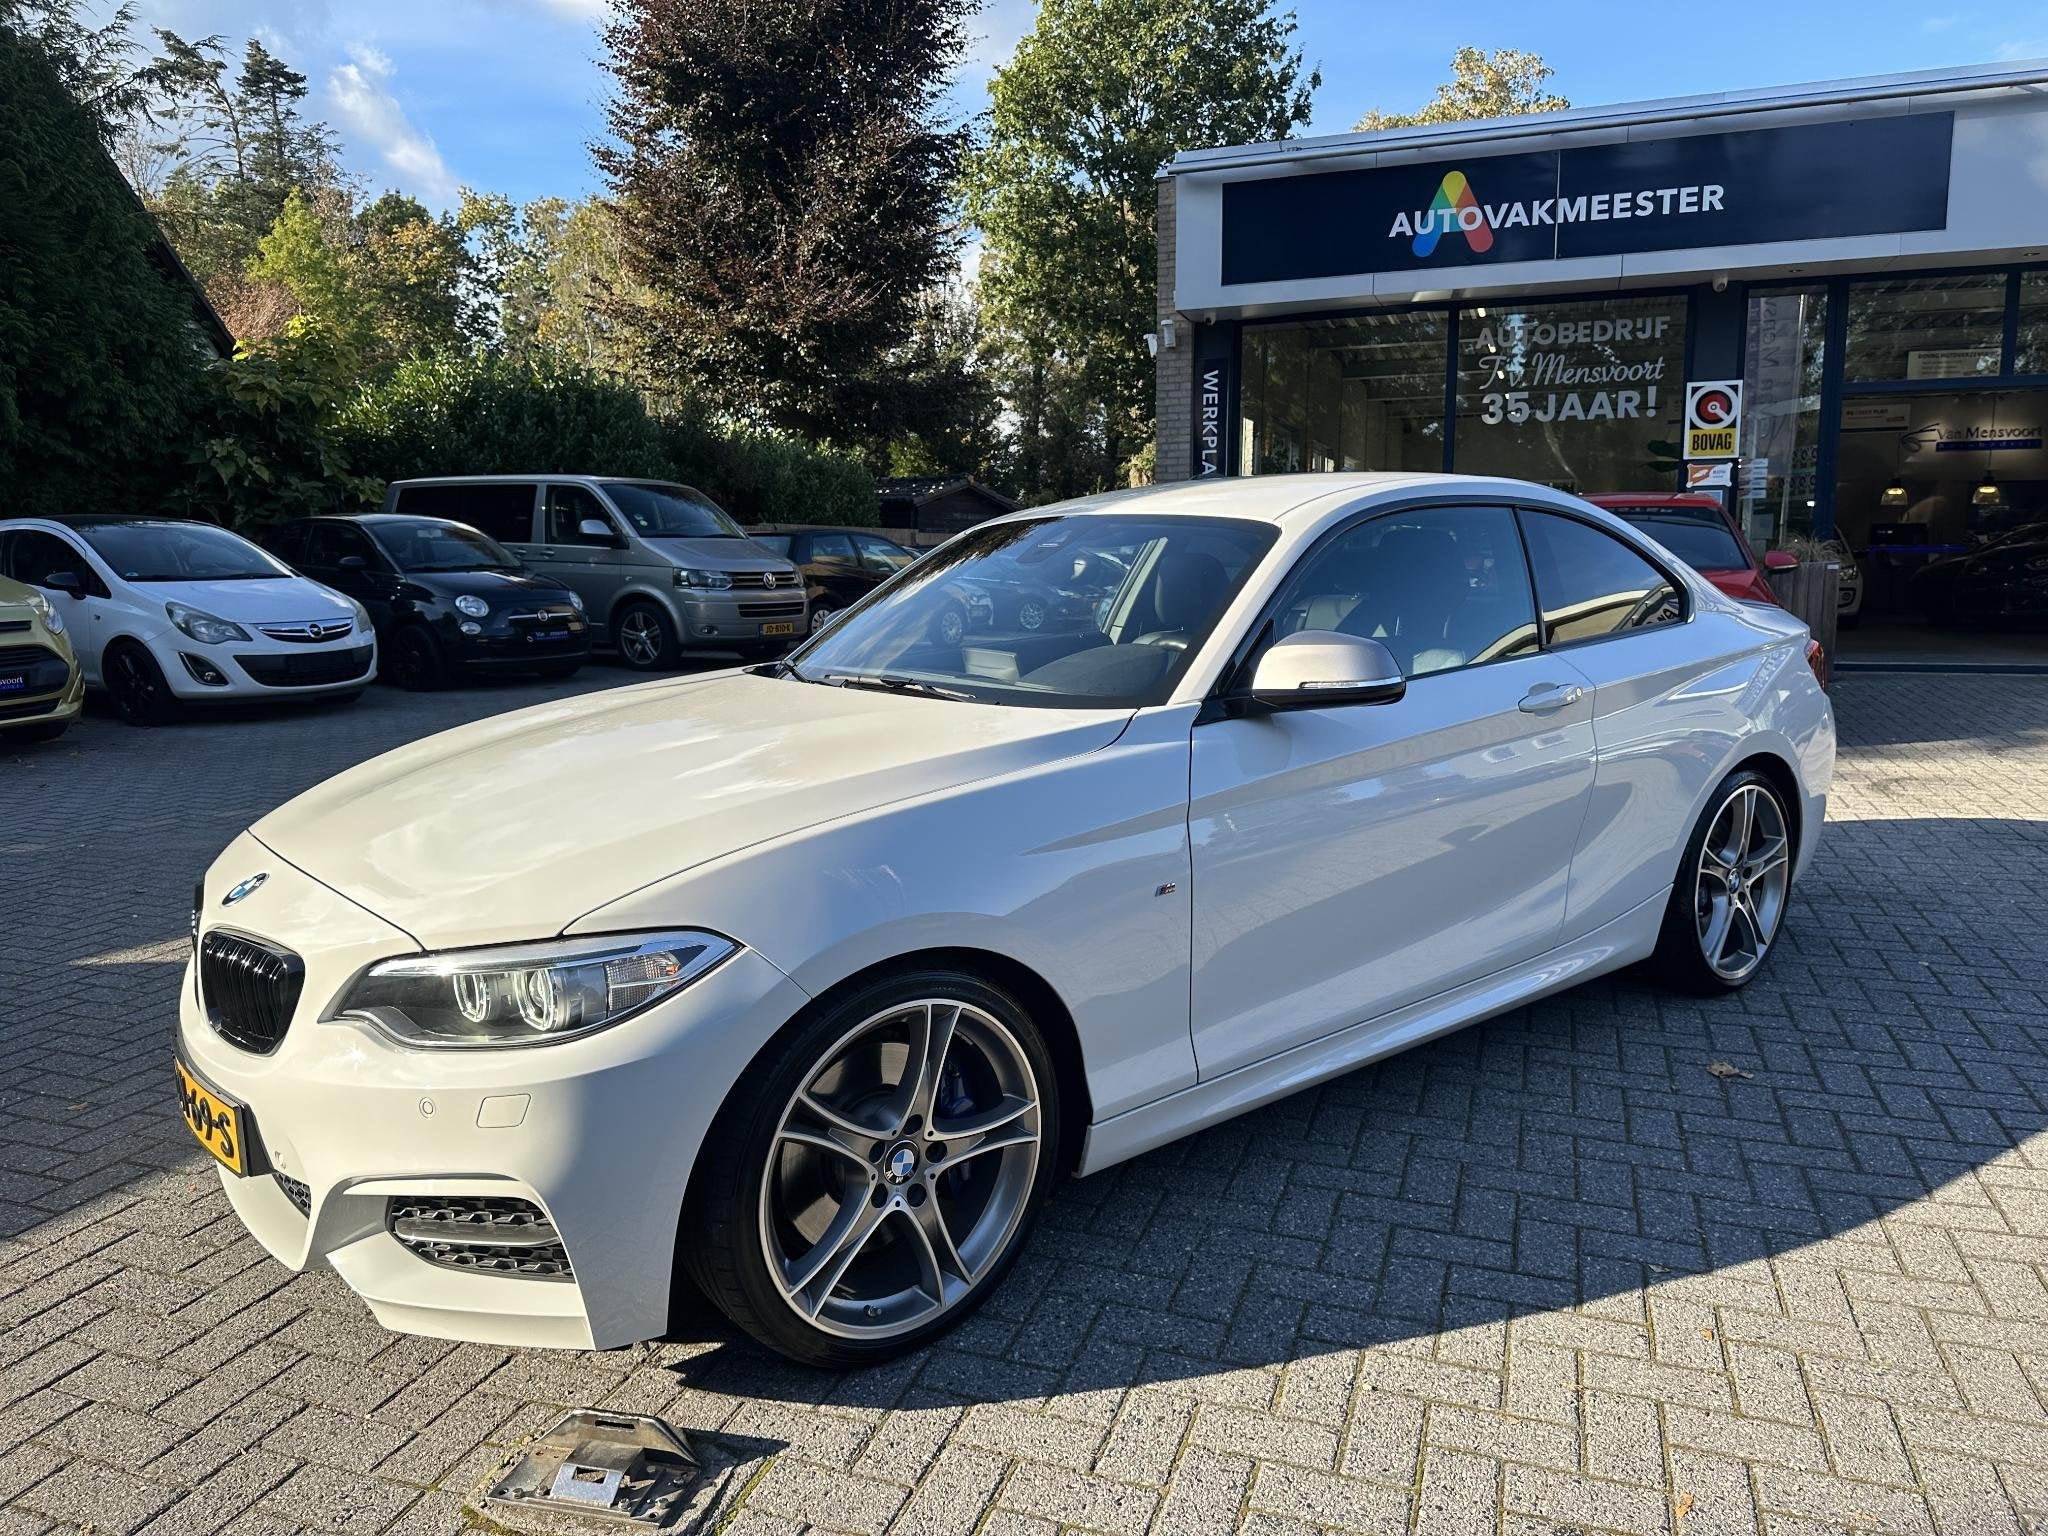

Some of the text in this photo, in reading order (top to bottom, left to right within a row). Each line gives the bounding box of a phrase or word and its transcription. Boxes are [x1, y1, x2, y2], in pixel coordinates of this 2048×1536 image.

[1388, 184, 1724, 238] AUTOVAKMEESTER
[1476, 316, 1671, 349] AUTOBEDRIJF
[1532, 352, 1665, 386] Mensvoort
[1201, 369, 1219, 475] WERKPLA
[1481, 385, 1657, 425] 35 JAAR!
[1692, 433, 1732, 451] BOVAG
[1937, 426, 2042, 440] Van Mensvoort
